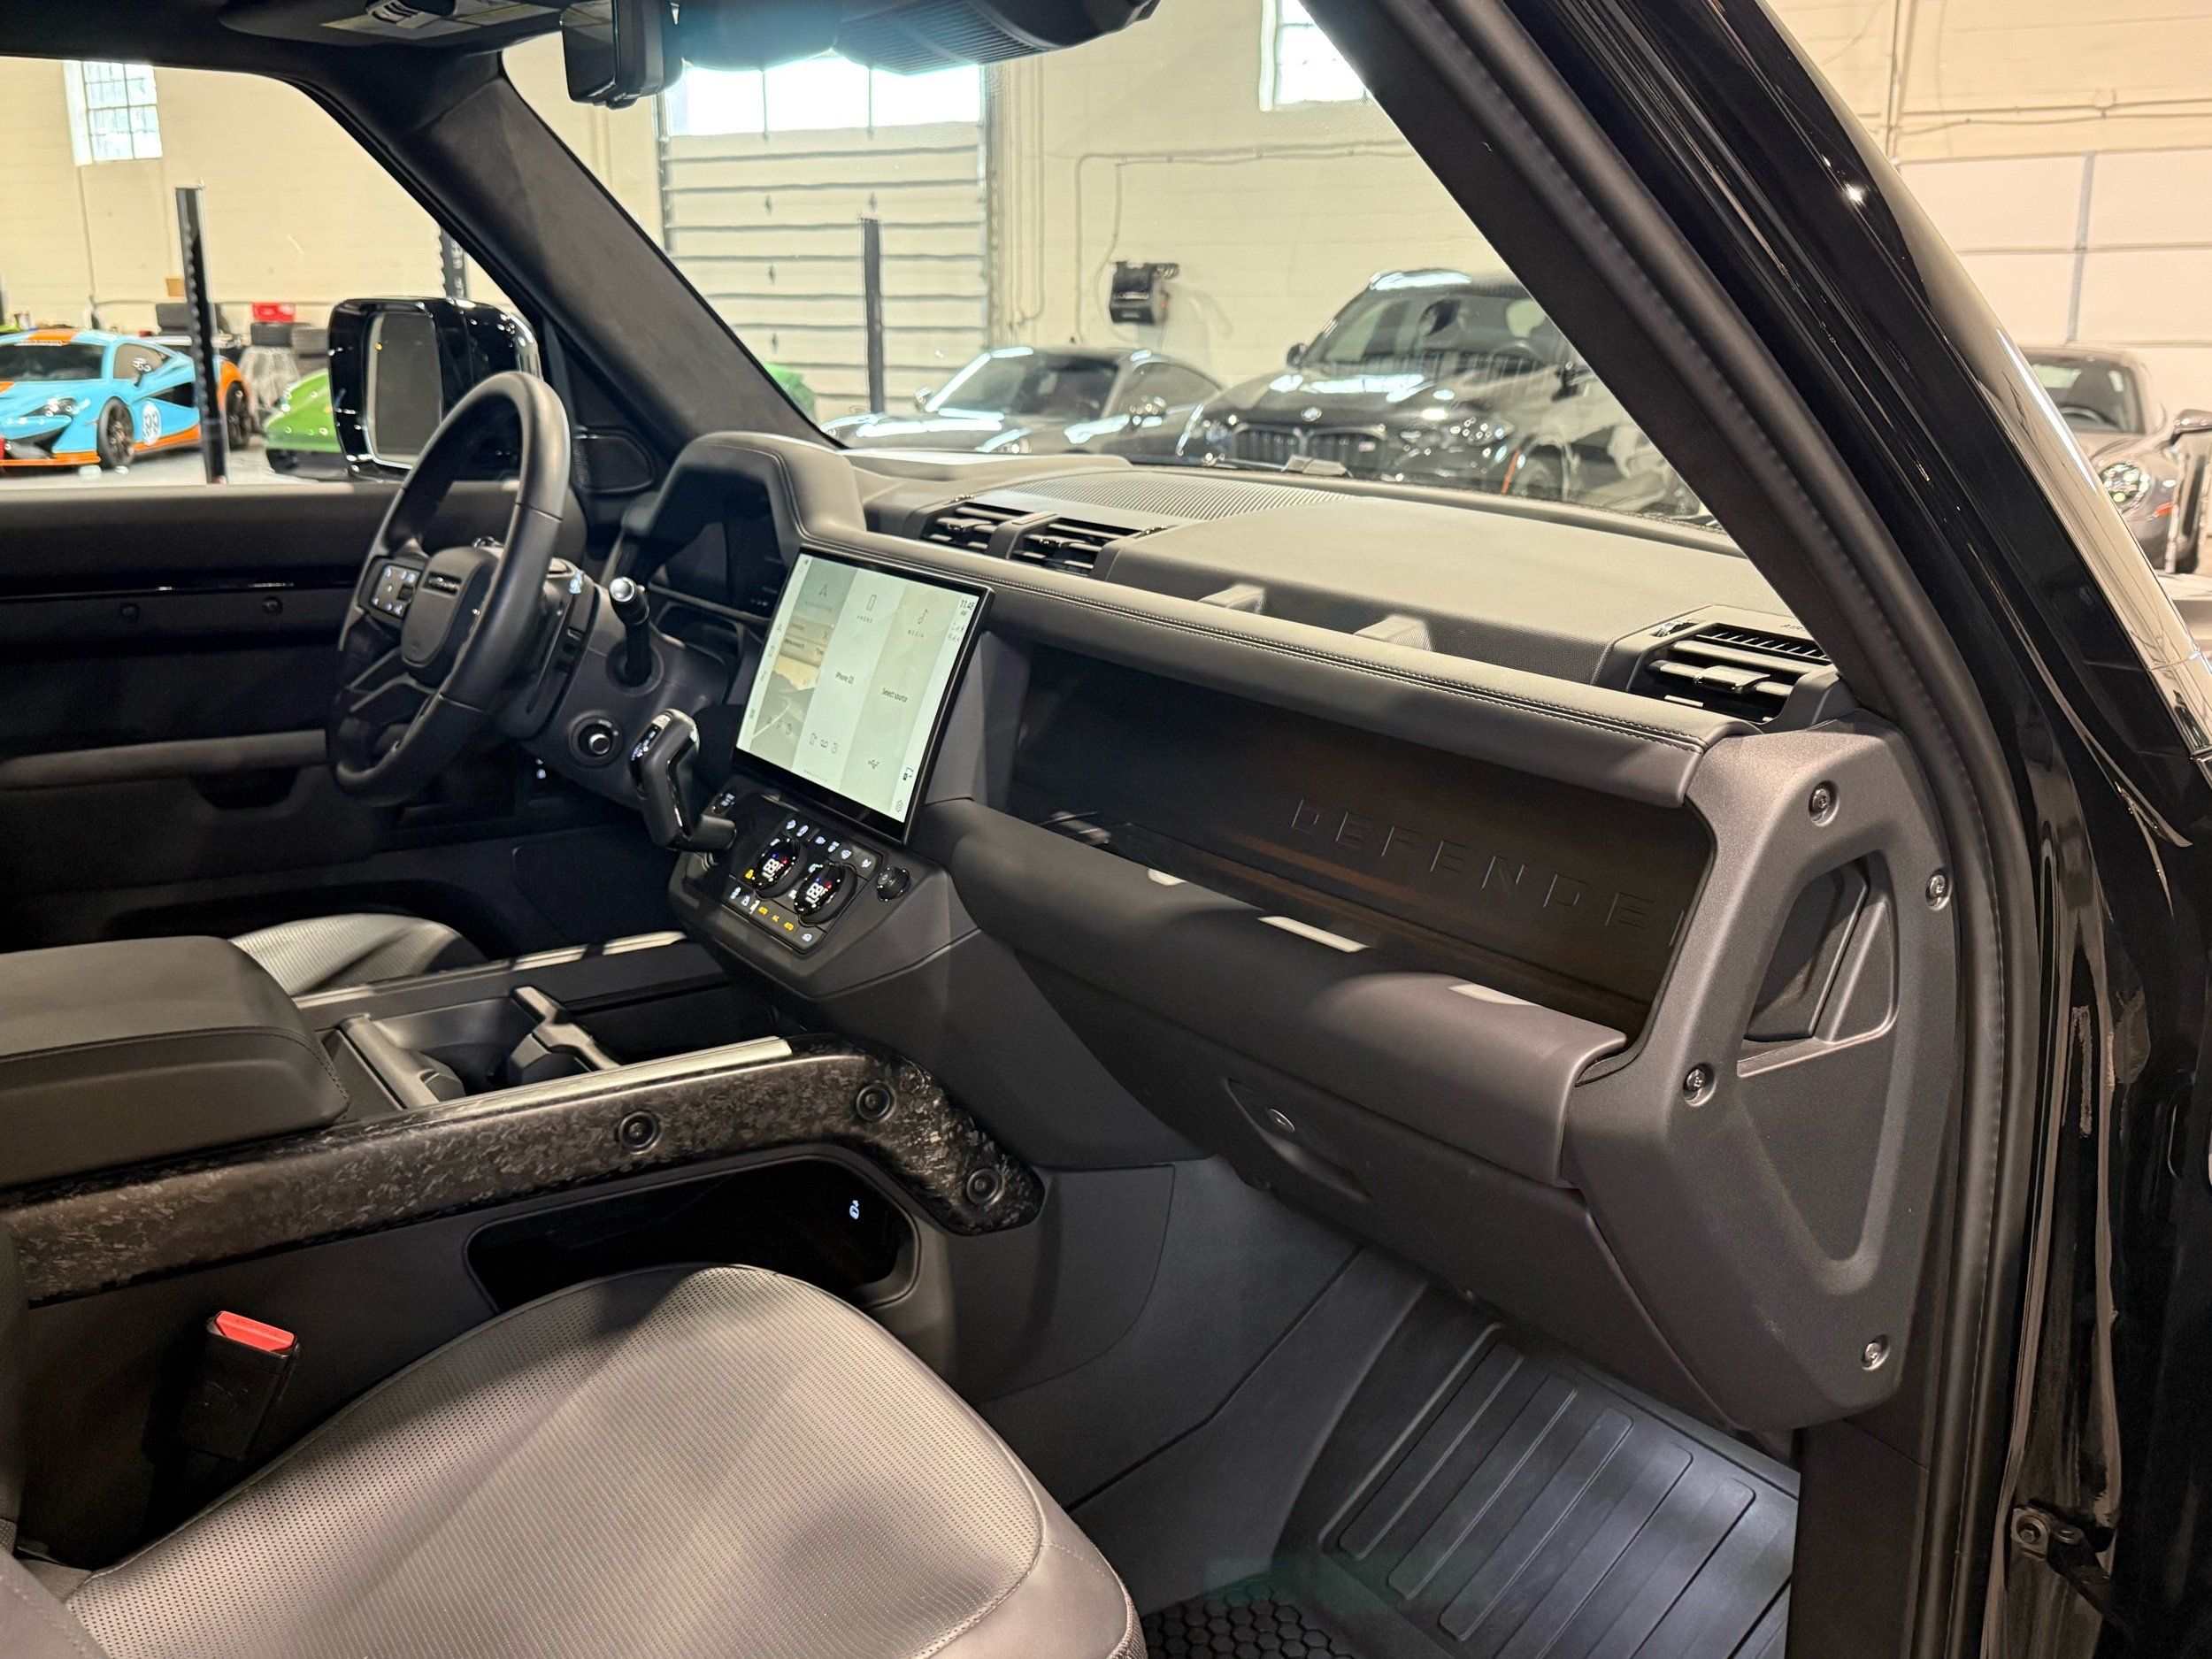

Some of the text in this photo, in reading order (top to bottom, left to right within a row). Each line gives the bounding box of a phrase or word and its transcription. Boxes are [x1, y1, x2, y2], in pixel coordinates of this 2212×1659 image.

[881, 687, 908, 703] Select source
[1290, 797, 1685, 946] DEFENDE
